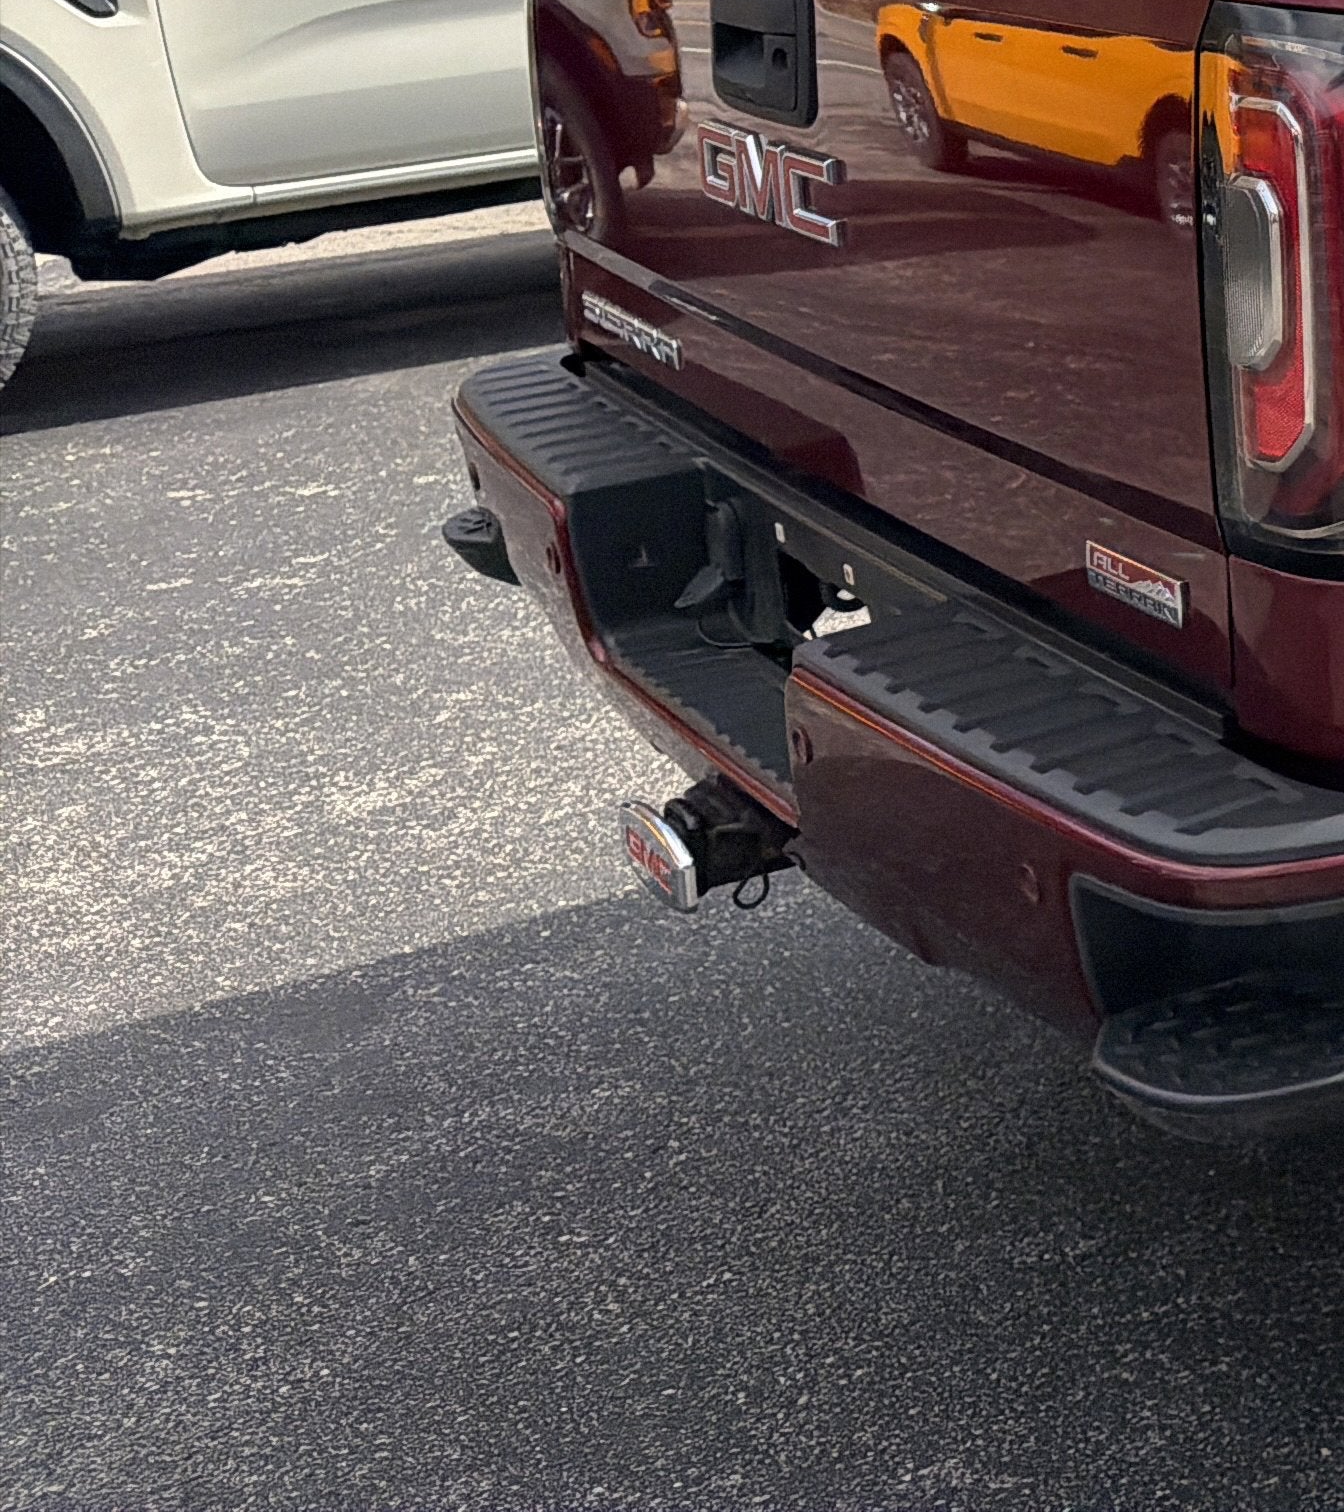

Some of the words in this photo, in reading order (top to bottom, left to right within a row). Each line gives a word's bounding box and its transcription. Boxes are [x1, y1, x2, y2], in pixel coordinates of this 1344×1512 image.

[697, 118, 848, 248] GMC
[1092, 550, 1130, 581] ALL
[1087, 570, 1179, 625] TERRAIN
